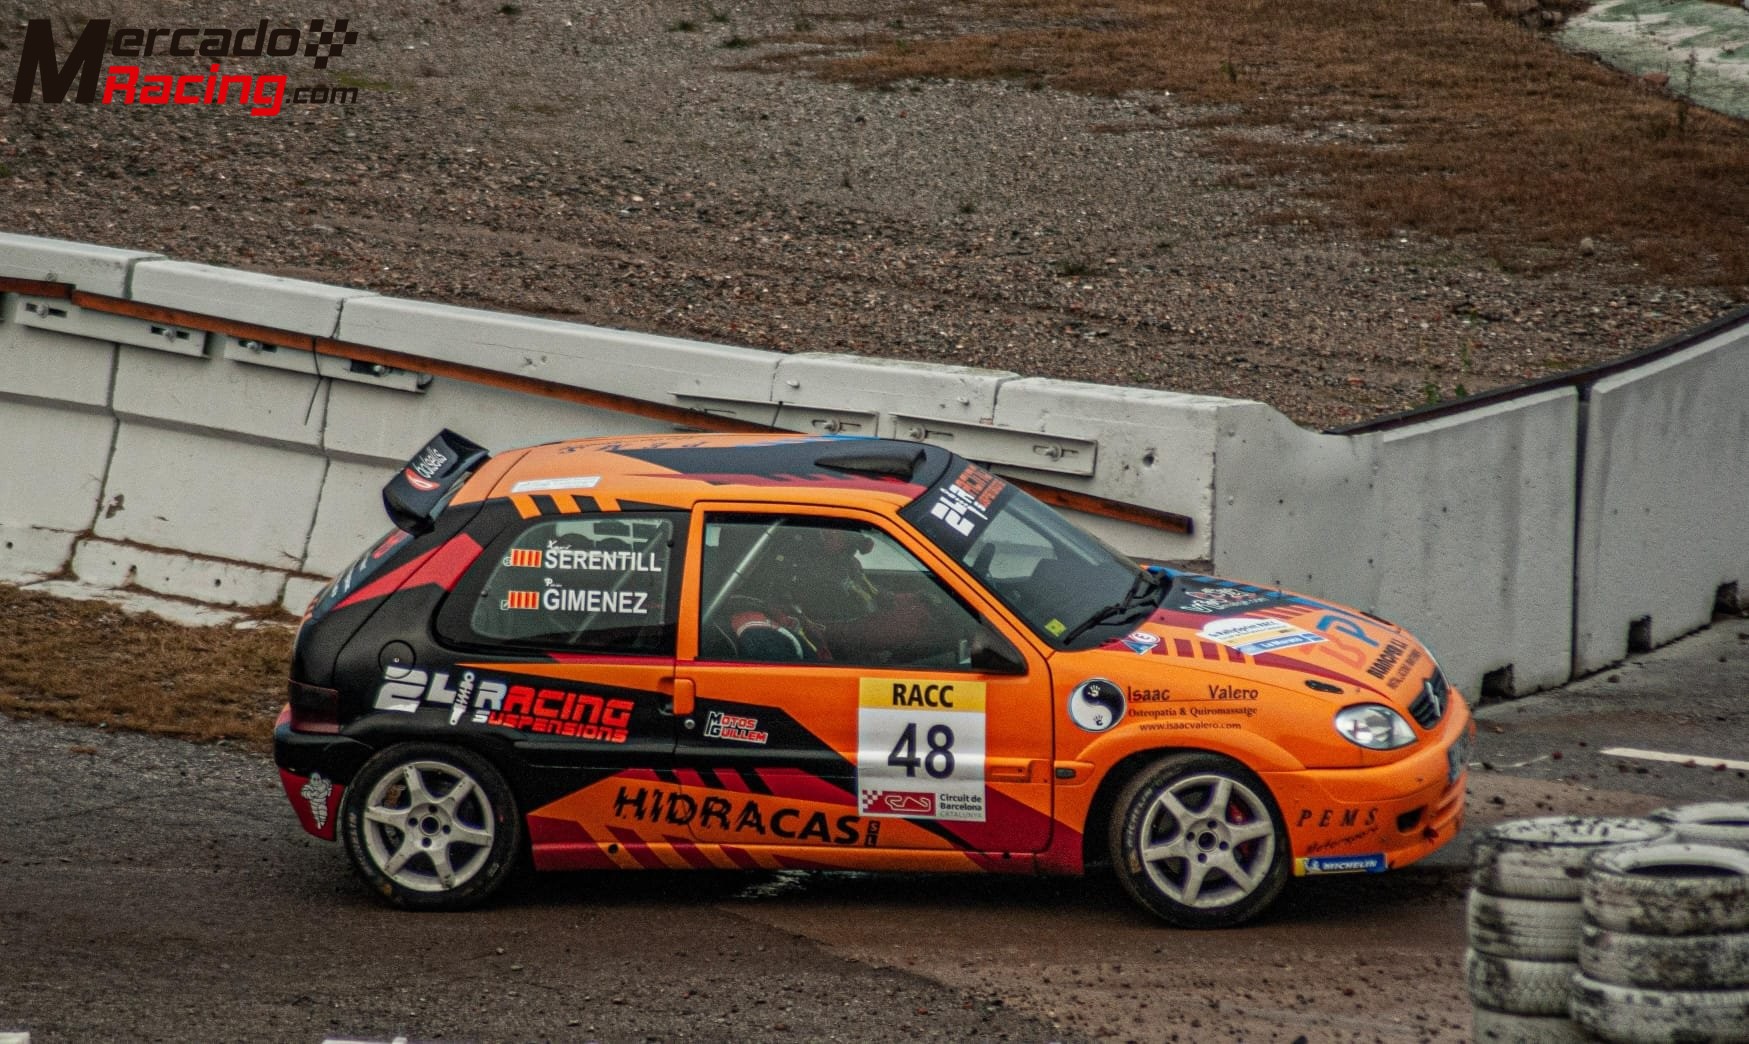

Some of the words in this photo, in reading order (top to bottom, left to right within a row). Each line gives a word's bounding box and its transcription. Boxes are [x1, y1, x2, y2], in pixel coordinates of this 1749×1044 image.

[544, 549, 662, 572] SERENTILL
[543, 589, 648, 614] GIMENEZ
[892, 683, 954, 708] RACC
[1127, 686, 1170, 701] Isaac
[1208, 684, 1259, 701] Valero
[477, 681, 635, 728] RACING
[1179, 708, 1187, 716] &
[1190, 707, 1258, 718] Quiromassatge
[1139, 721, 1242, 731] www.isaacvalero.com
[887, 722, 955, 779] 48
[940, 793, 969, 803] Circuit
[971, 793, 982, 803] de
[940, 802, 982, 812] Barcelona
[614, 786, 861, 845] HIDRACAS
[1296, 807, 1379, 828] PEMS
[1322, 859, 1378, 870] MICHELIN
